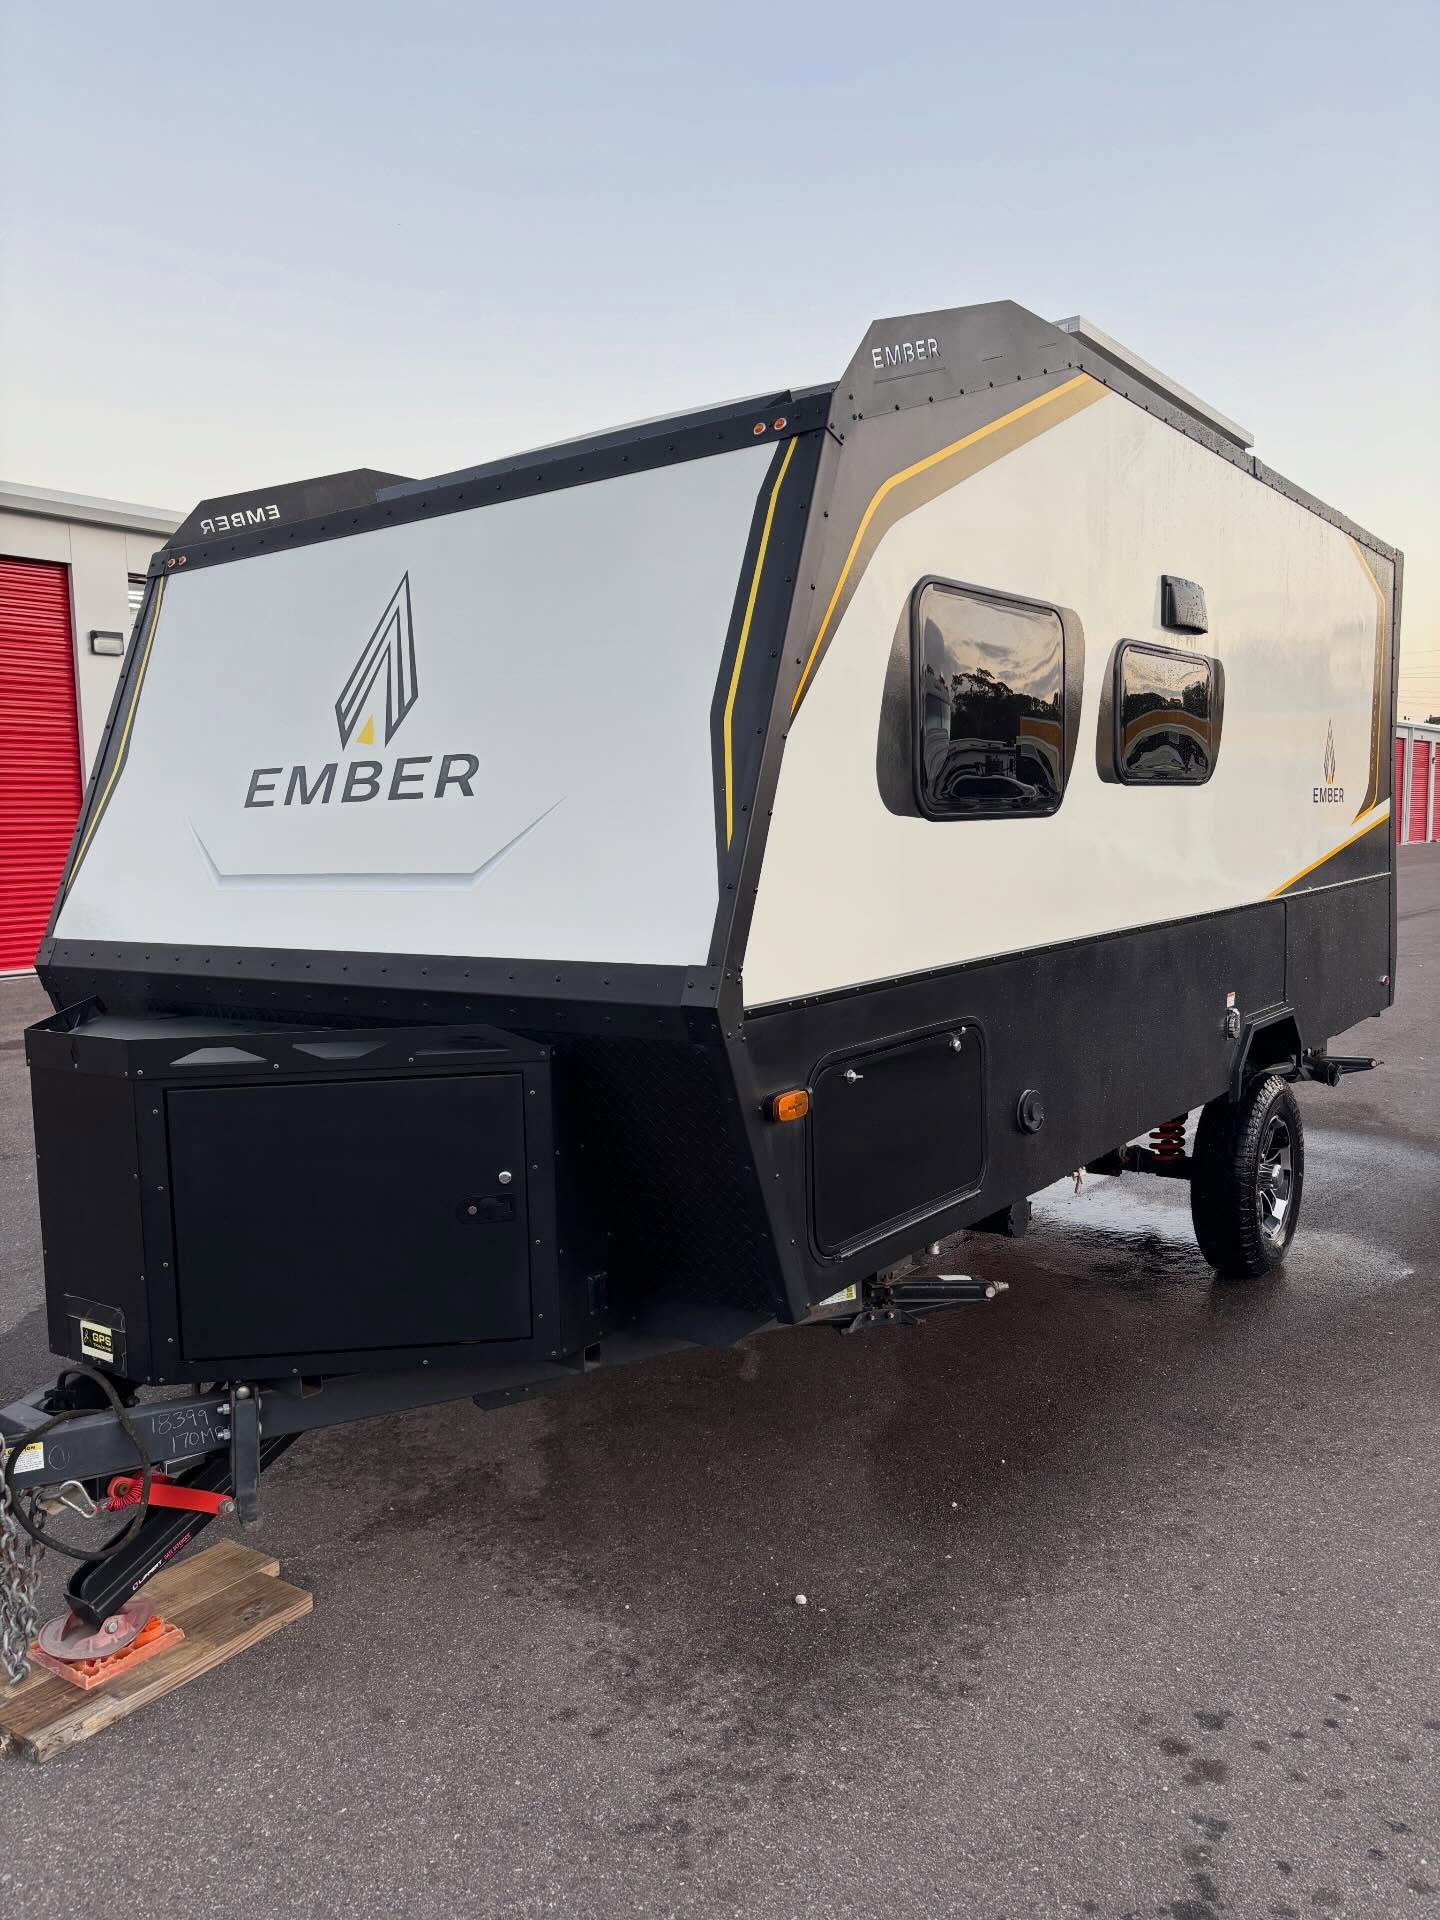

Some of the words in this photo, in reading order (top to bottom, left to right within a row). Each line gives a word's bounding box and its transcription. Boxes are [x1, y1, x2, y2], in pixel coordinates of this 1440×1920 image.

[871, 338, 941, 369] EMBER
[243, 753, 480, 808] EMBER
[1312, 787, 1345, 803] EMBER
[92, 1332, 112, 1347] GPS
[151, 1409, 209, 1435] 18399
